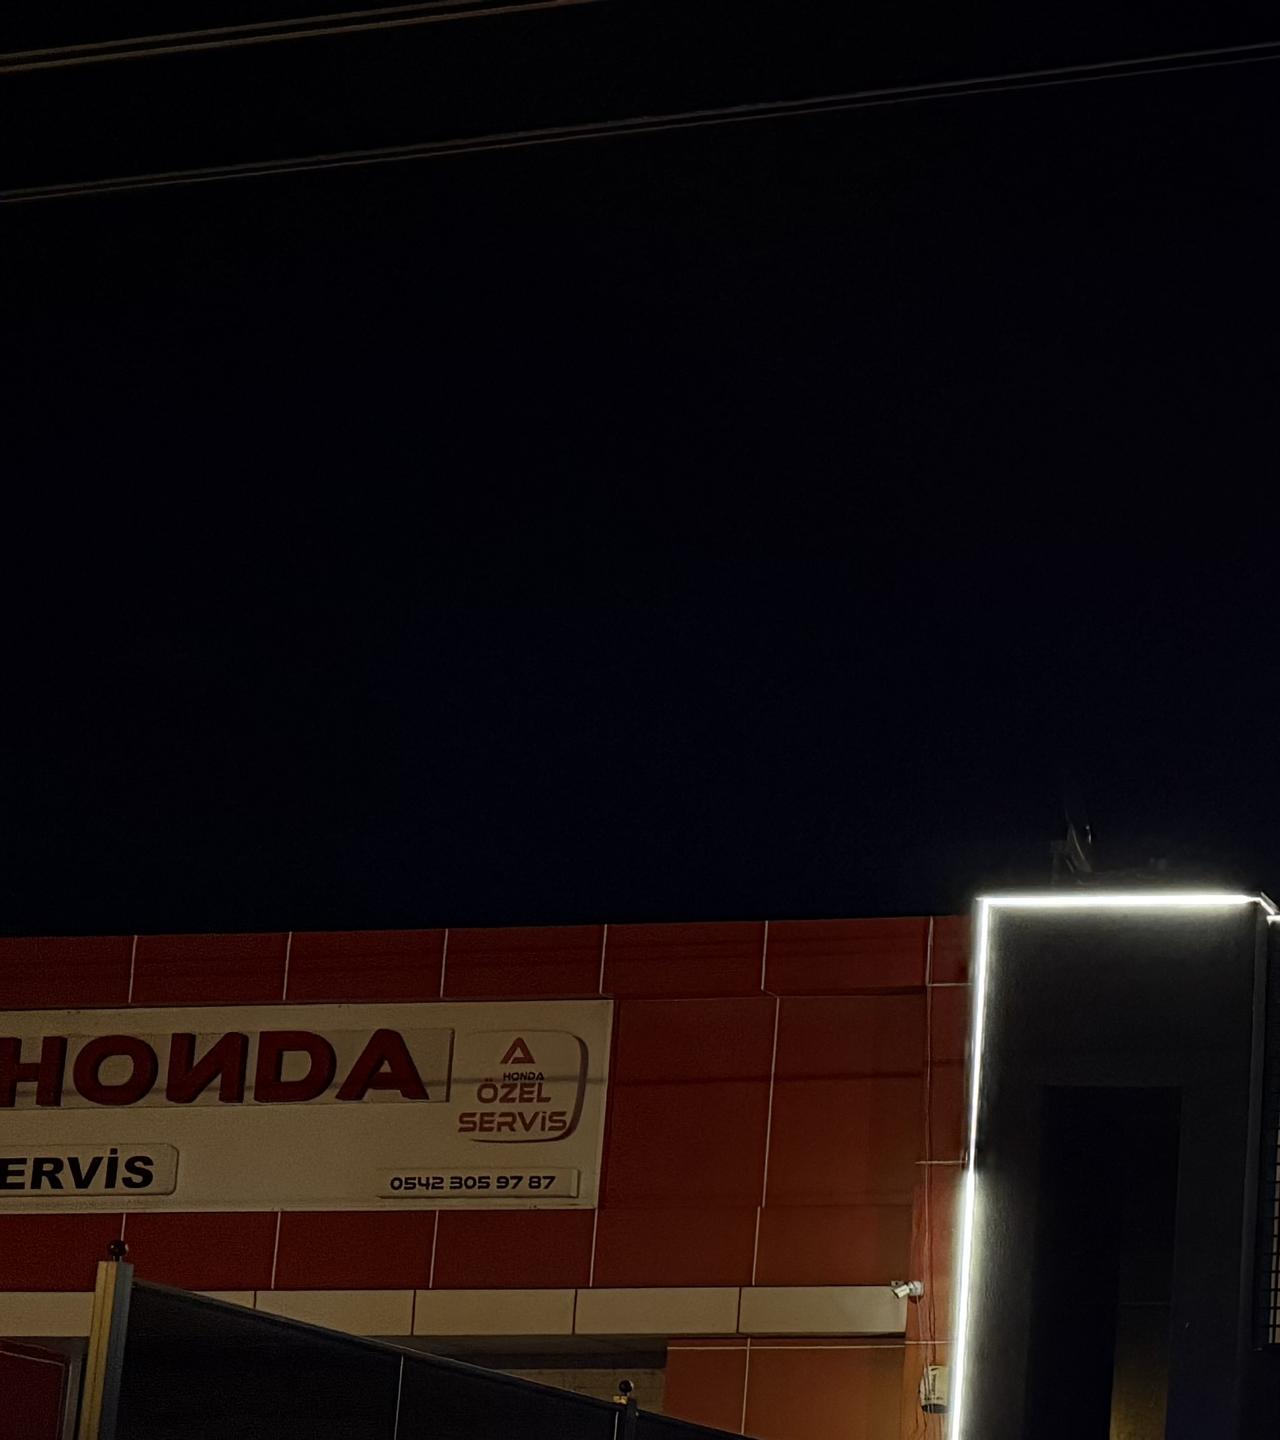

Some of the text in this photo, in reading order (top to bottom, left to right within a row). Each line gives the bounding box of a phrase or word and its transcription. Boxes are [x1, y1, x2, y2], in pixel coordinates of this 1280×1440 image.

[477, 1078, 552, 1103] ÖZEL
[0, 1148, 154, 1190] ERVİS
[390, 1176, 556, 1190] 0542 305 97 87
